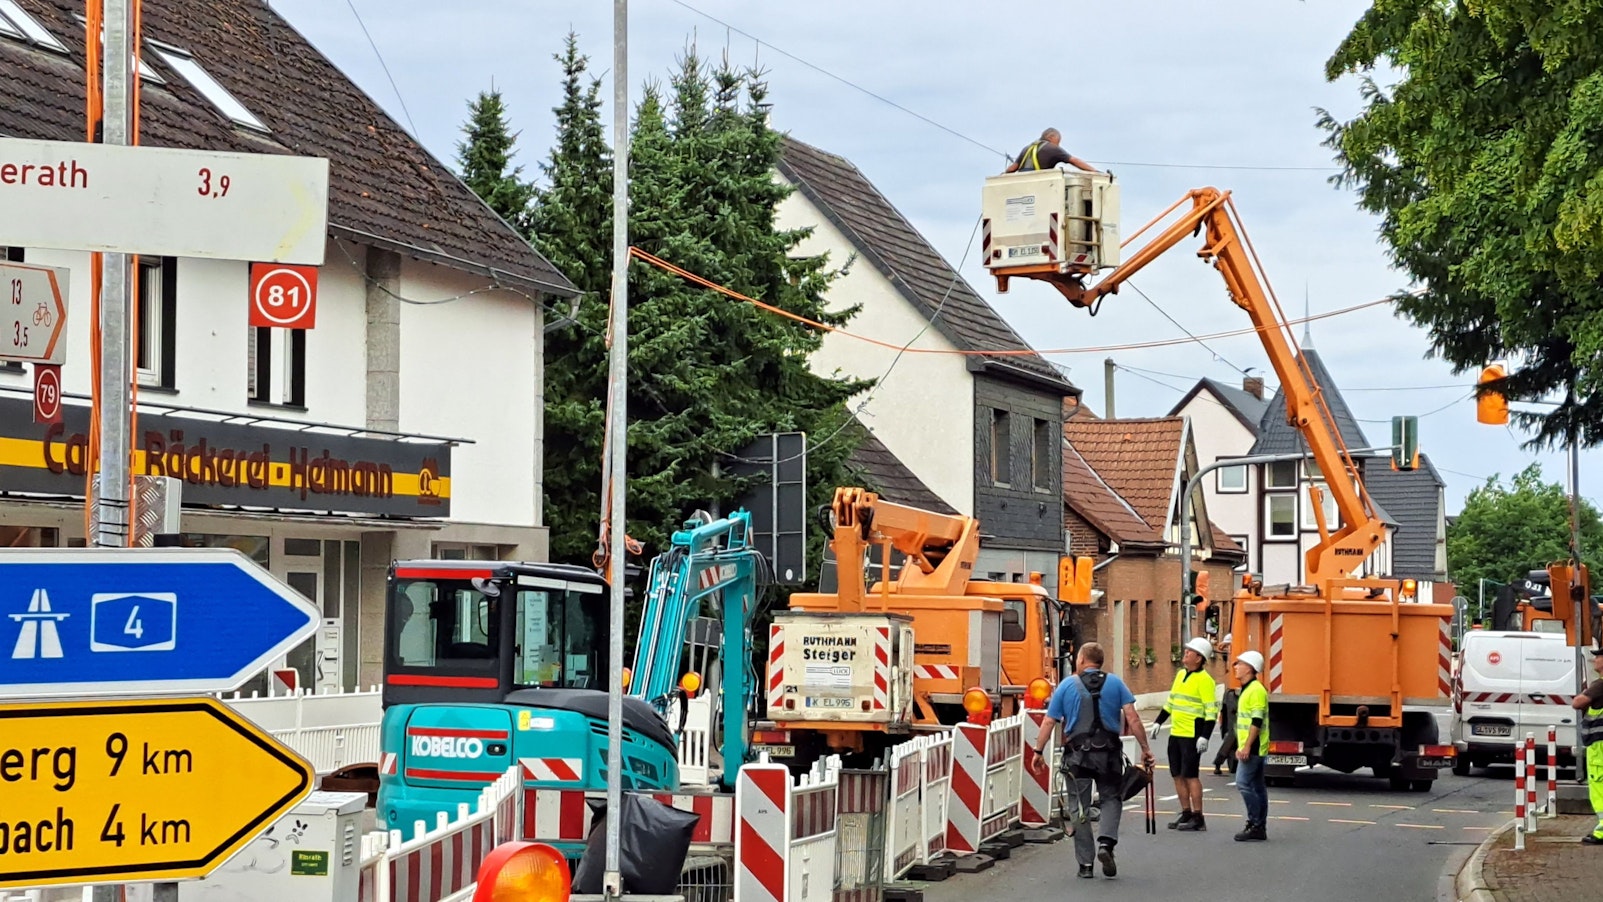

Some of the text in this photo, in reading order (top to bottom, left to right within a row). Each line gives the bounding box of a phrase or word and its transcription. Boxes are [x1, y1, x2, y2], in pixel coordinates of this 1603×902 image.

[0, 160, 231, 199] erath 3,9
[11, 278, 22, 305] 13
[267, 285, 300, 308] 81
[13, 320, 29, 347] 3,5
[40, 383, 56, 404] 79
[145, 429, 271, 490] Bäckerei
[289, 446, 394, 501] Heimann
[124, 605, 144, 639] 4
[803, 636, 857, 647] RUTHMANN
[803, 648, 856, 663] Steiger
[785, 685, 798, 693] 21
[823, 698, 834, 706] EL
[411, 735, 484, 759] KOBELCO
[0, 732, 193, 792] erg 9 km
[100, 803, 126, 848] 4
[140, 812, 191, 846] km
